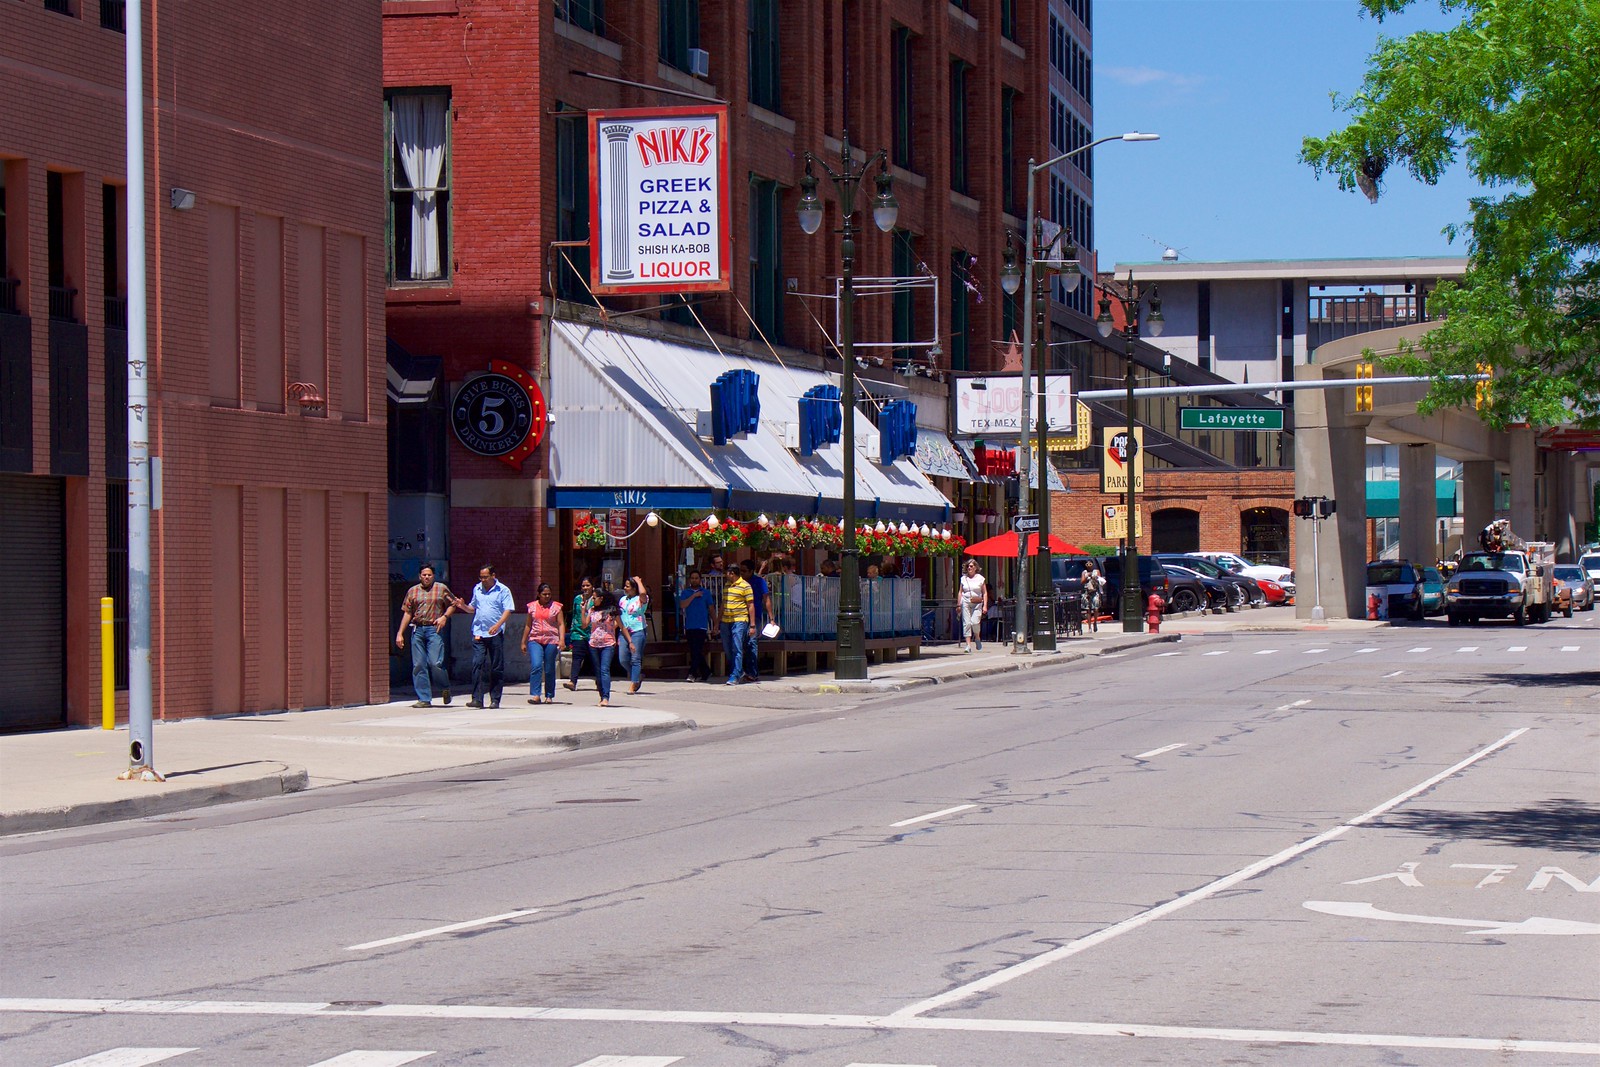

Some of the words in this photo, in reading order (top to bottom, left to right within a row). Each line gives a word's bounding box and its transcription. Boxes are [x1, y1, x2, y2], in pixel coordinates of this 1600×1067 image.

[640, 177, 712, 193] GREEK
[639, 200, 693, 215] PIZZA
[699, 198, 711, 213] &
[638, 222, 711, 237] SALAD
[638, 244, 669, 255] SHISH
[671, 243, 710, 254] KA-BOB
[639, 261, 711, 278] LIQUOR
[462, 381, 489, 403] FIVE
[491, 380, 525, 409] BUCKS
[478, 396, 506, 435] 5
[971, 419, 990, 428] TEX
[994, 418, 1017, 428] MEX
[1199, 413, 1265, 426] Lafayette
[460, 427, 521, 451] DRINKERY
[1107, 476, 1141, 488] PARKG
[1022, 520, 1031, 528] ONE
